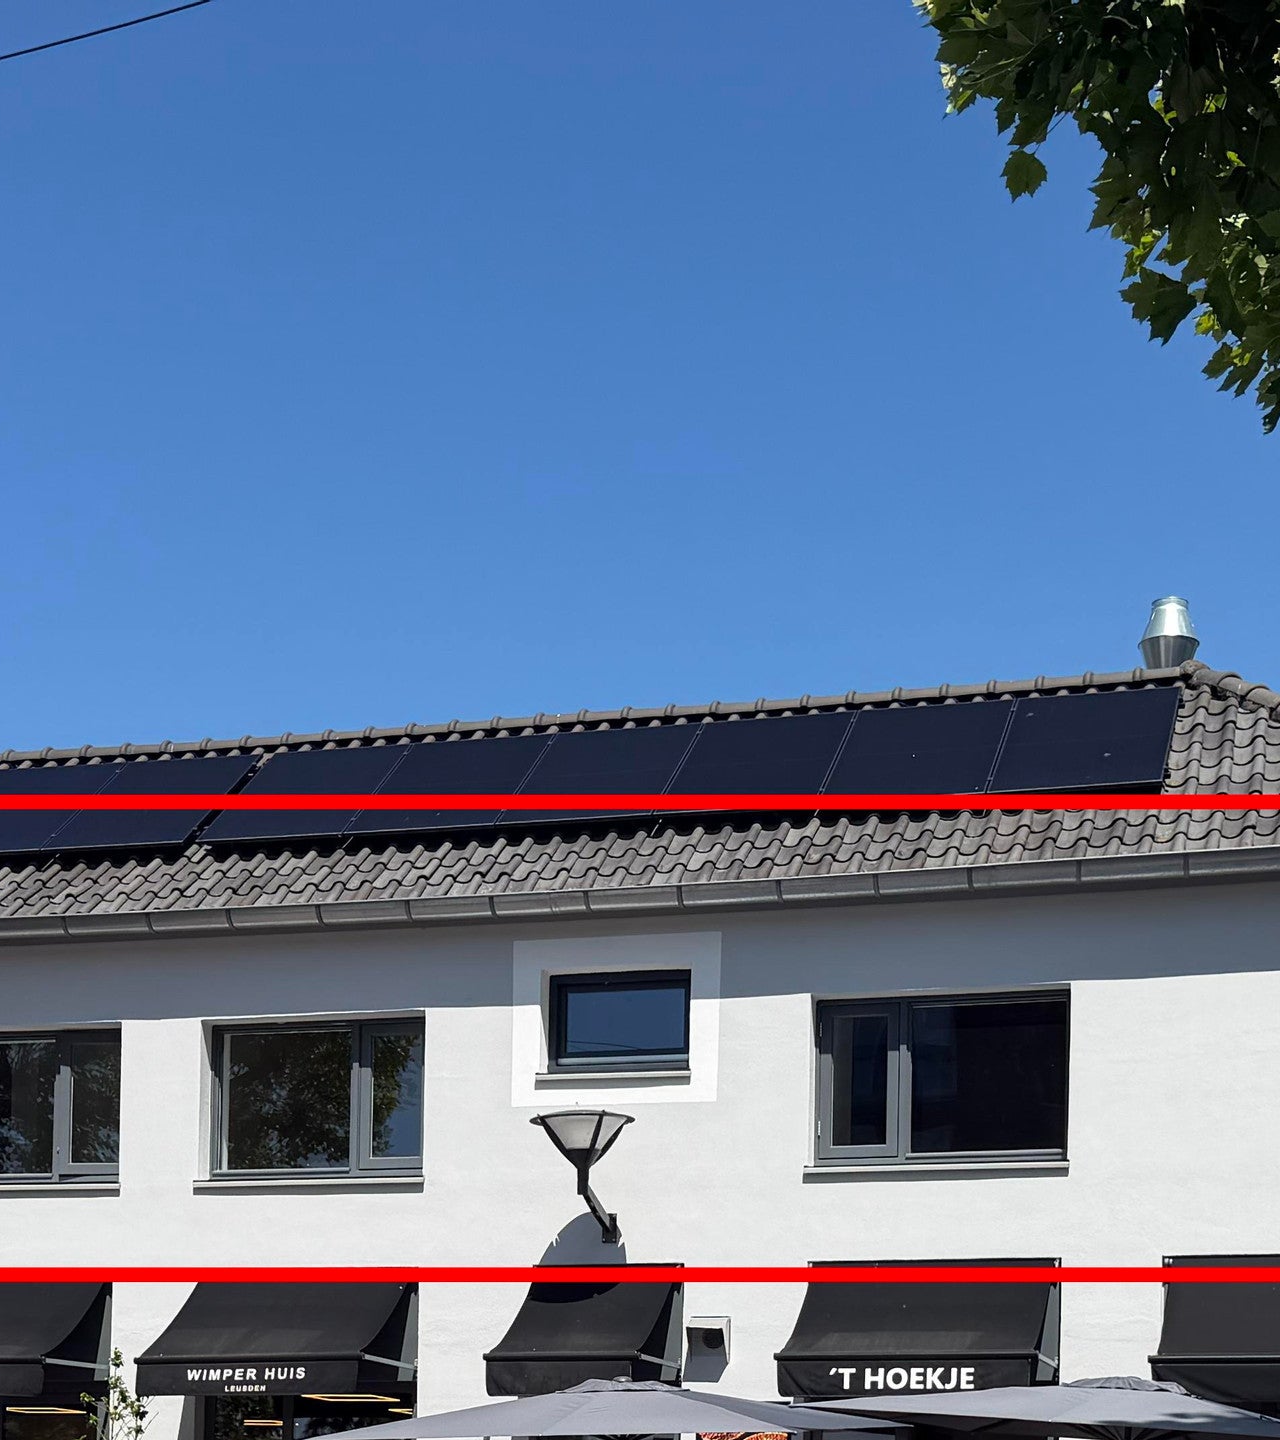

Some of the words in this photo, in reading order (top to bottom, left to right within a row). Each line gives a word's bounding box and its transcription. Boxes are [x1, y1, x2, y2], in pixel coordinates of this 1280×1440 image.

[186, 1367, 257, 1381] WIMPER
[264, 1366, 306, 1380] HUIS
[864, 1367, 975, 1390] HOEKJE
[224, 1384, 266, 1392] LEUSDEN
